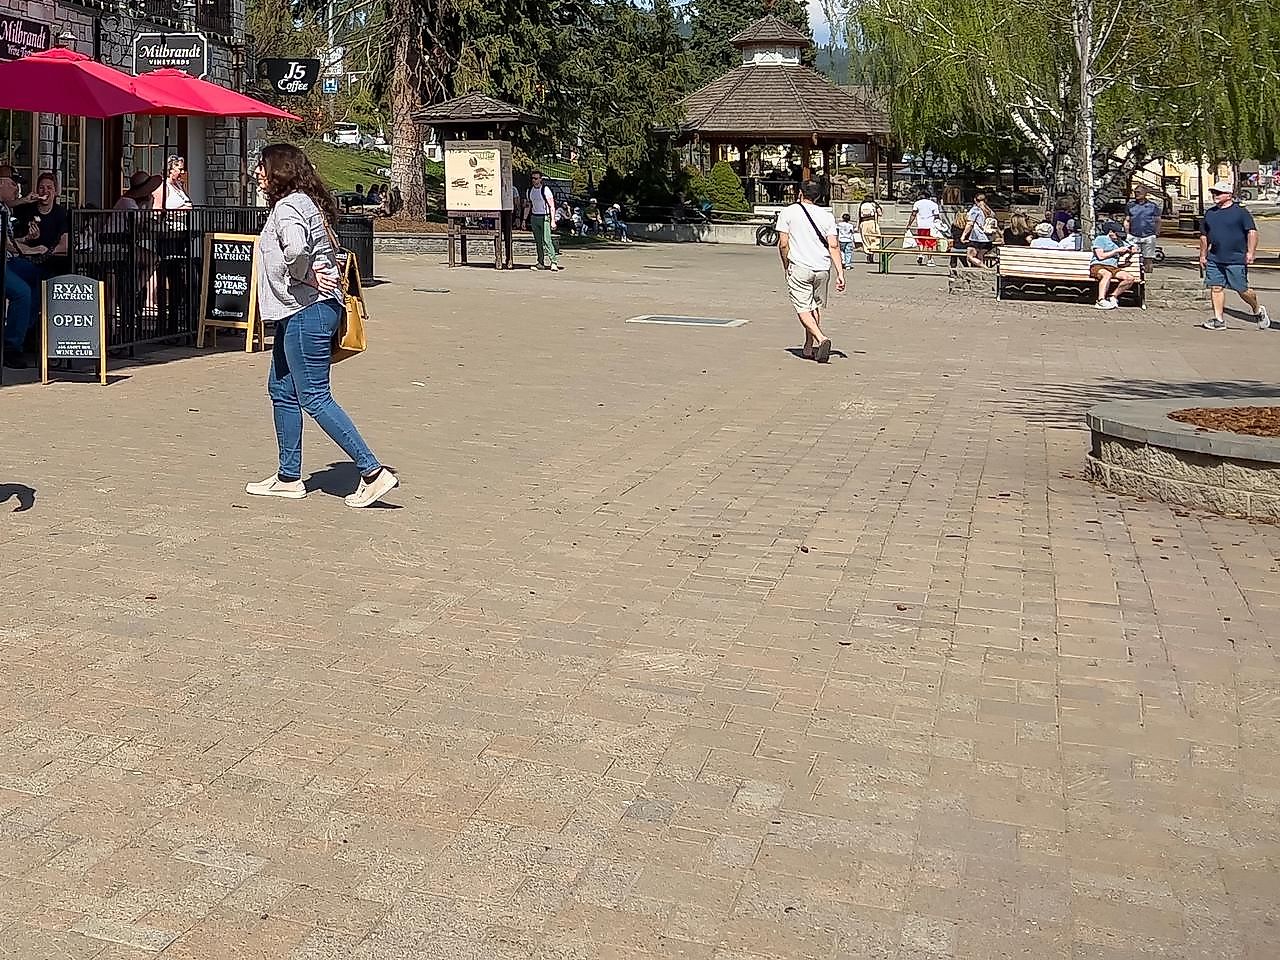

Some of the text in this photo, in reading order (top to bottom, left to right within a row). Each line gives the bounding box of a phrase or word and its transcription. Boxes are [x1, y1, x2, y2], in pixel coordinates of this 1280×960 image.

[0, 20, 46, 49] Milbrandt
[138, 43, 201, 58] Milbrandt
[284, 62, 307, 79] J5
[277, 78, 309, 92] Coffee
[214, 243, 252, 254] RYAN
[213, 253, 251, 261] PATRICK
[53, 284, 93, 293] RYAN
[214, 280, 248, 290] 20 YEARS
[53, 315, 94, 327] OPEN
